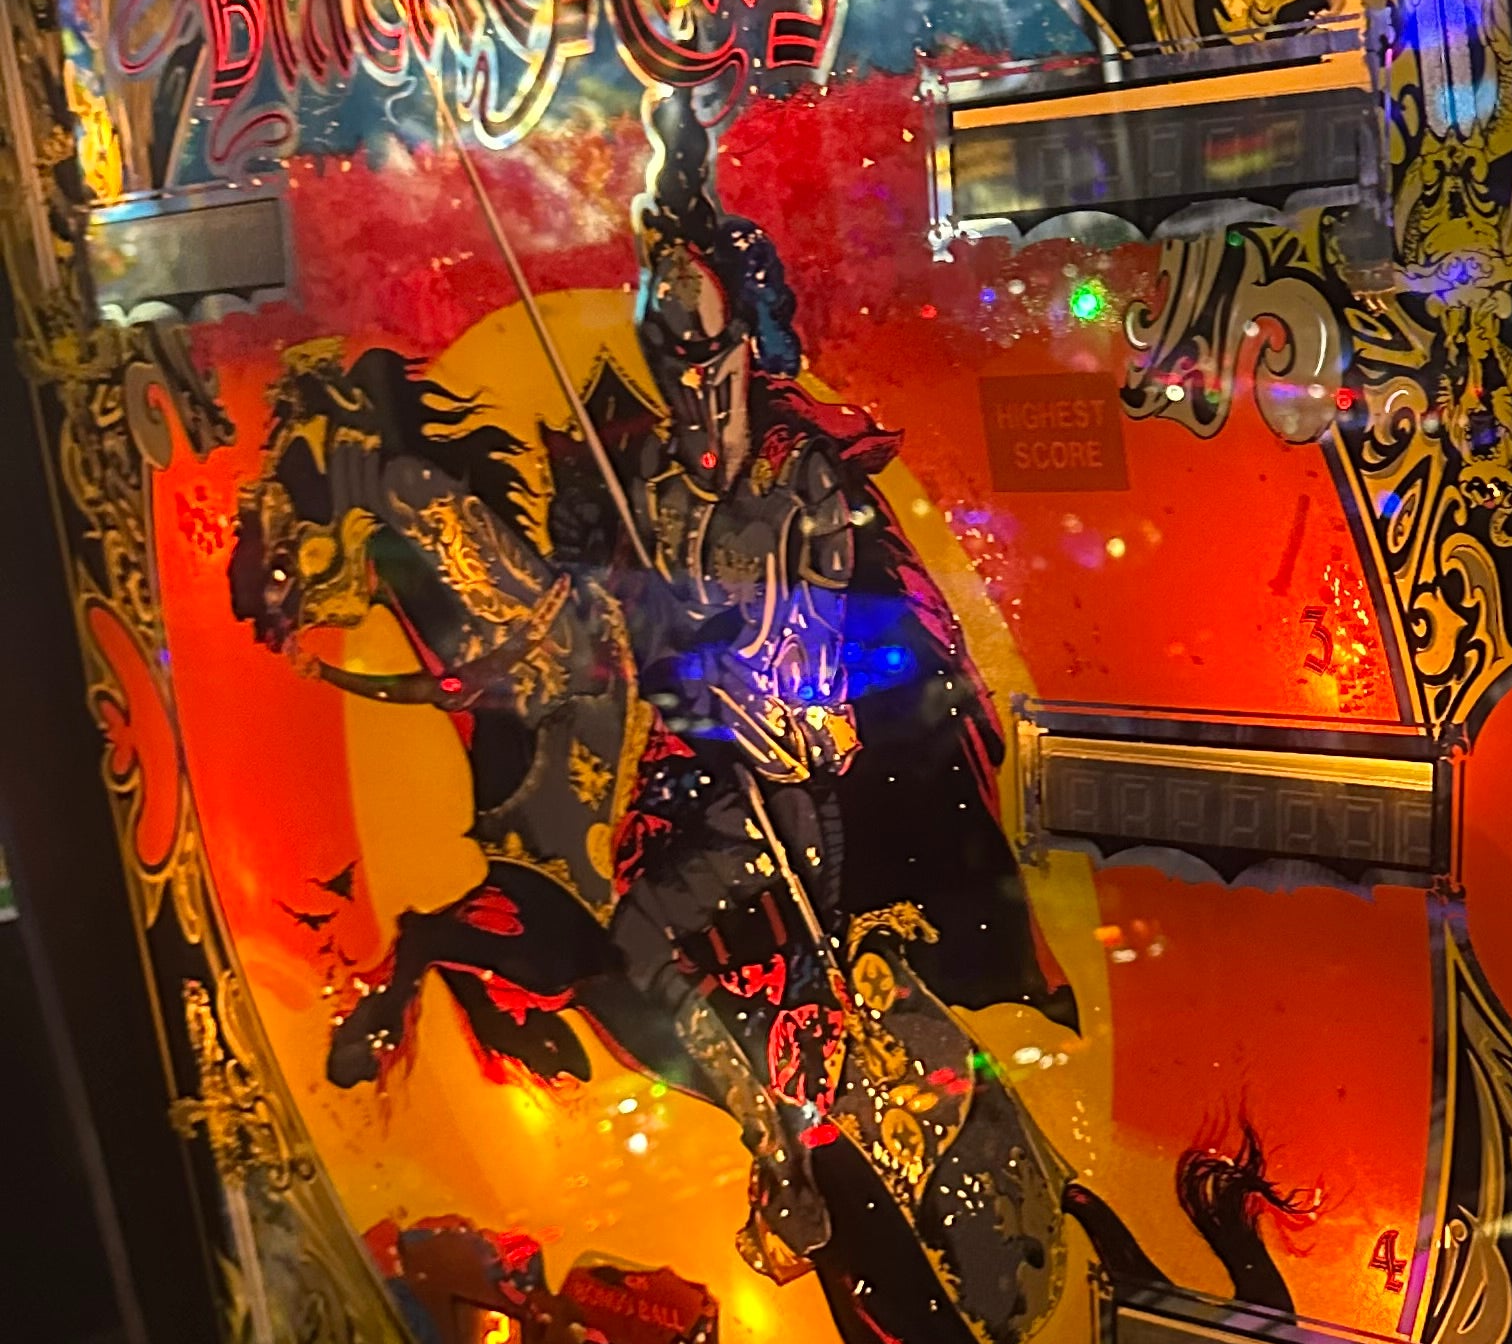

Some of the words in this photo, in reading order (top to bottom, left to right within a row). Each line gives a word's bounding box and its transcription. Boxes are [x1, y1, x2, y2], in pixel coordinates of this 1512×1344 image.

[996, 399, 1105, 430] HIGHEST
[1014, 440, 1103, 470] SCORE
[1300, 605, 1334, 676] 3
[1368, 1229, 1408, 1293] 4
